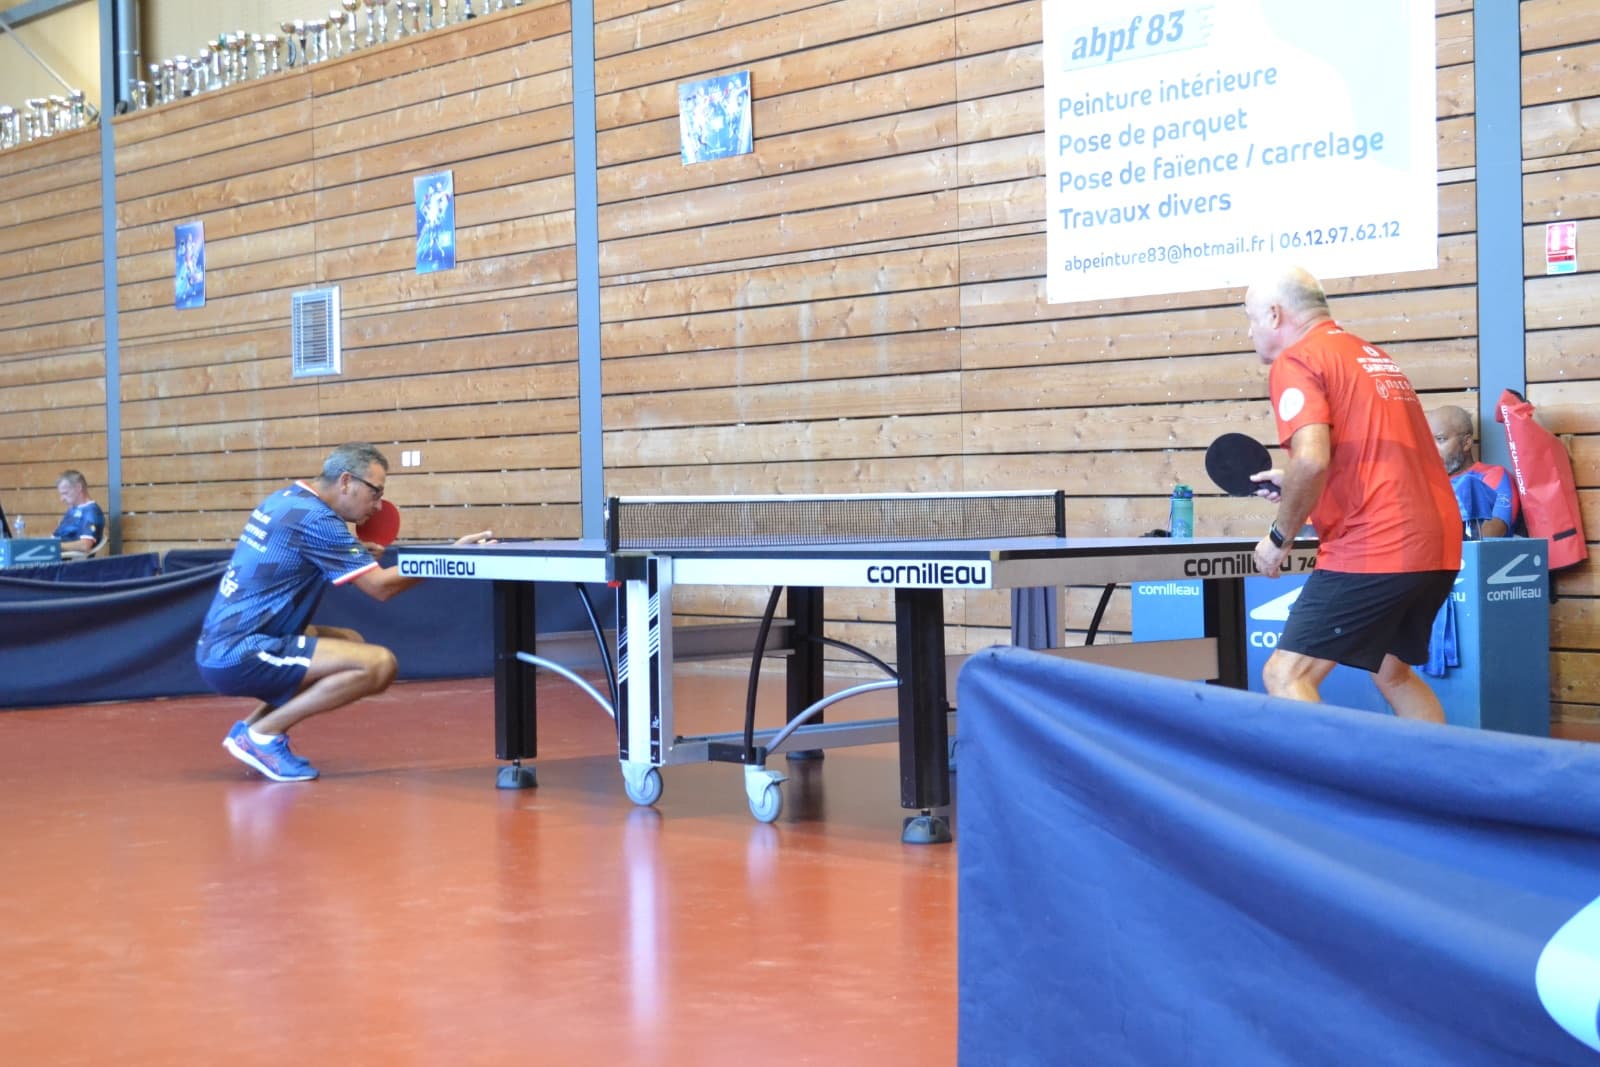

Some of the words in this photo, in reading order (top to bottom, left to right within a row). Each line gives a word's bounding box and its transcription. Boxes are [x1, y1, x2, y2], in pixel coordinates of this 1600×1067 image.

[1071, 16, 1143, 62] abpf
[1146, 10, 1185, 46] 83
[1059, 88, 1152, 119] Peinture
[1159, 66, 1278, 103] intérieure
[1059, 133, 1112, 157] Pose
[1118, 122, 1146, 147] de
[1153, 108, 1248, 149] parquet
[1059, 171, 1113, 193] Pose
[1119, 160, 1146, 185] de
[1153, 152, 1239, 181] faïence
[1245, 143, 1255, 169] /
[1261, 131, 1385, 166] carrelage
[1059, 203, 1151, 230] Travaux
[1158, 193, 1232, 219] divers
[1064, 234, 1265, 274] abpeinture83@hotmail.fr
[1279, 220, 1401, 250] 06.12.97.62.12
[401, 558, 476, 577] cornilleau
[867, 563, 986, 585] cornilleau
[1184, 553, 1292, 577] cornillu
[1138, 583, 1200, 596] cornilleau
[1486, 586, 1542, 602] cornilleau
